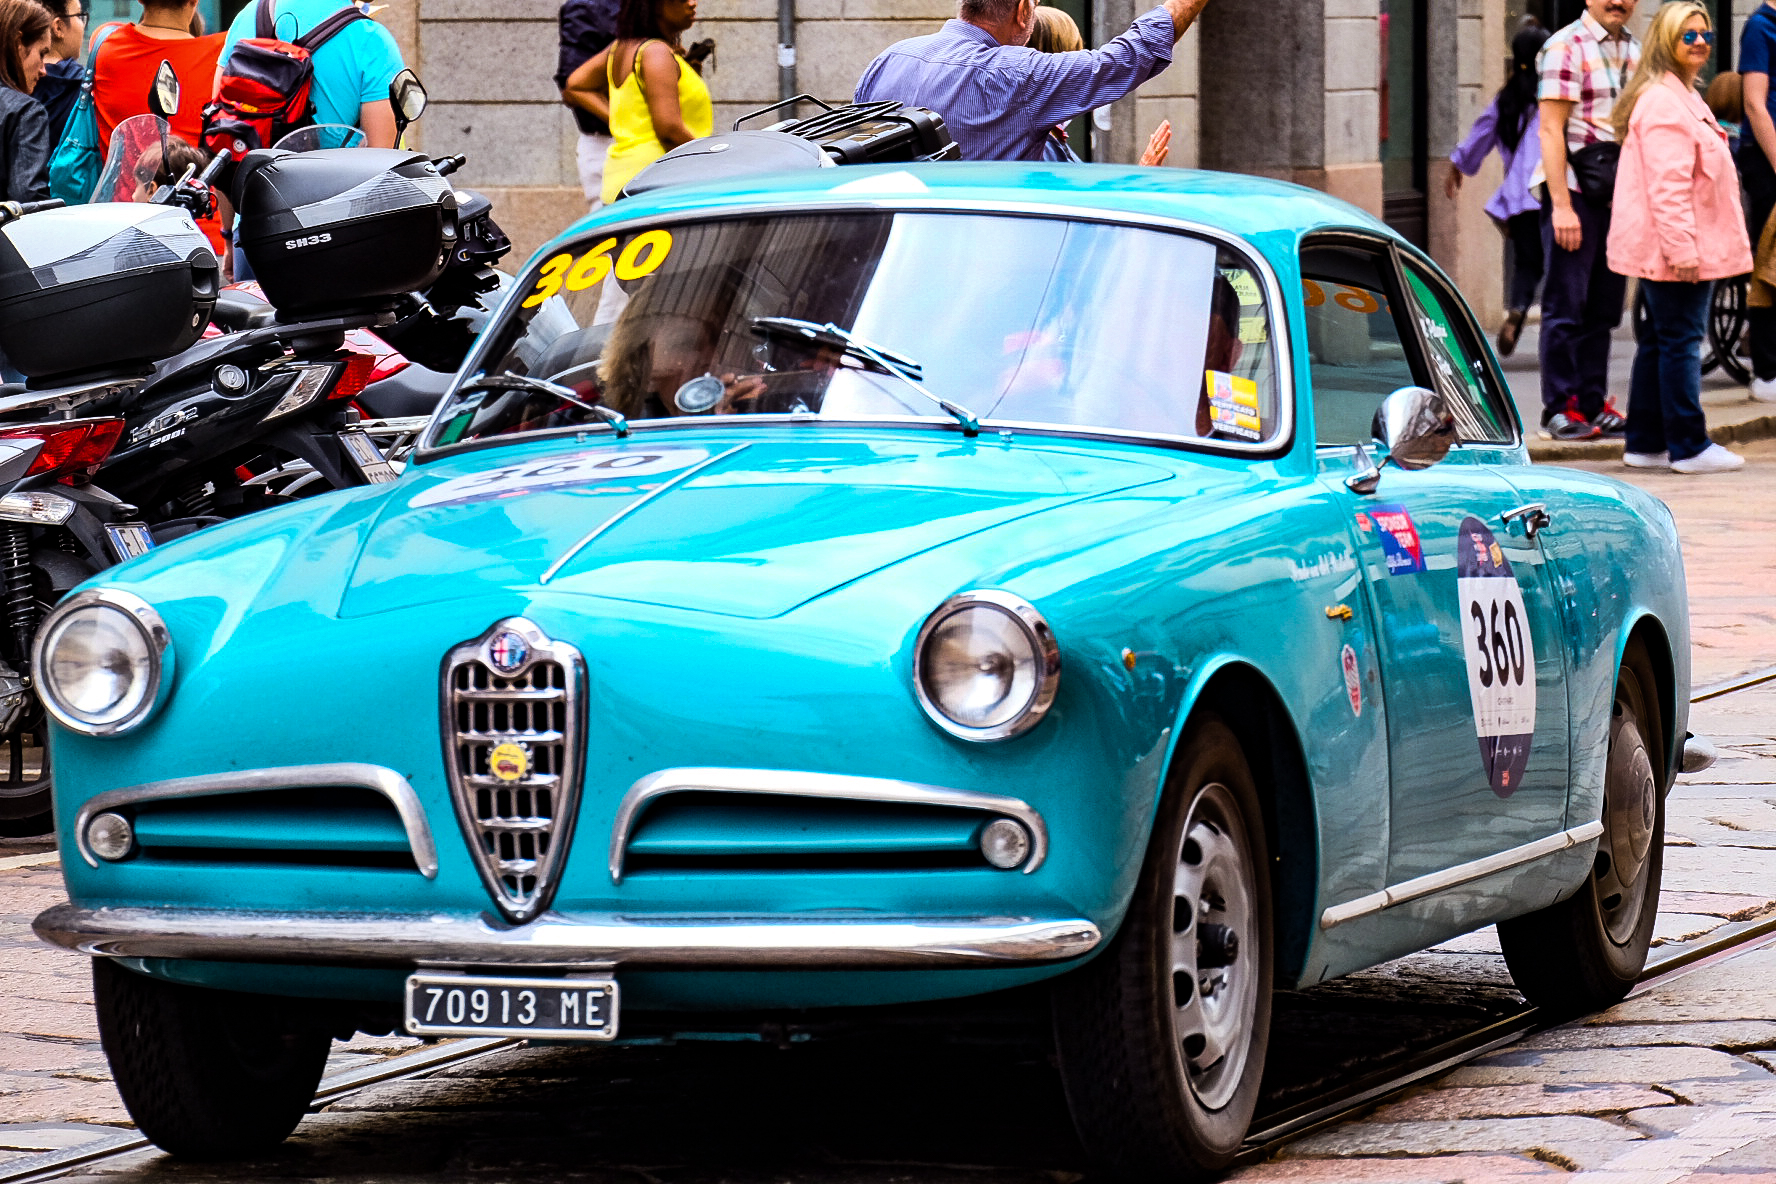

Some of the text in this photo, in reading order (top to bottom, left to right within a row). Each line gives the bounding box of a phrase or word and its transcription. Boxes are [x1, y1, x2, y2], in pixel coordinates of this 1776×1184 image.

[285, 233, 332, 250] SH33
[521, 229, 673, 309] 360
[1212, 420, 1261, 441] VERIFICATO
[453, 455, 664, 491] 360
[1376, 513, 1410, 533] SPONSOR
[1471, 598, 1525, 688] 360
[425, 988, 606, 1026] 70913 ME
